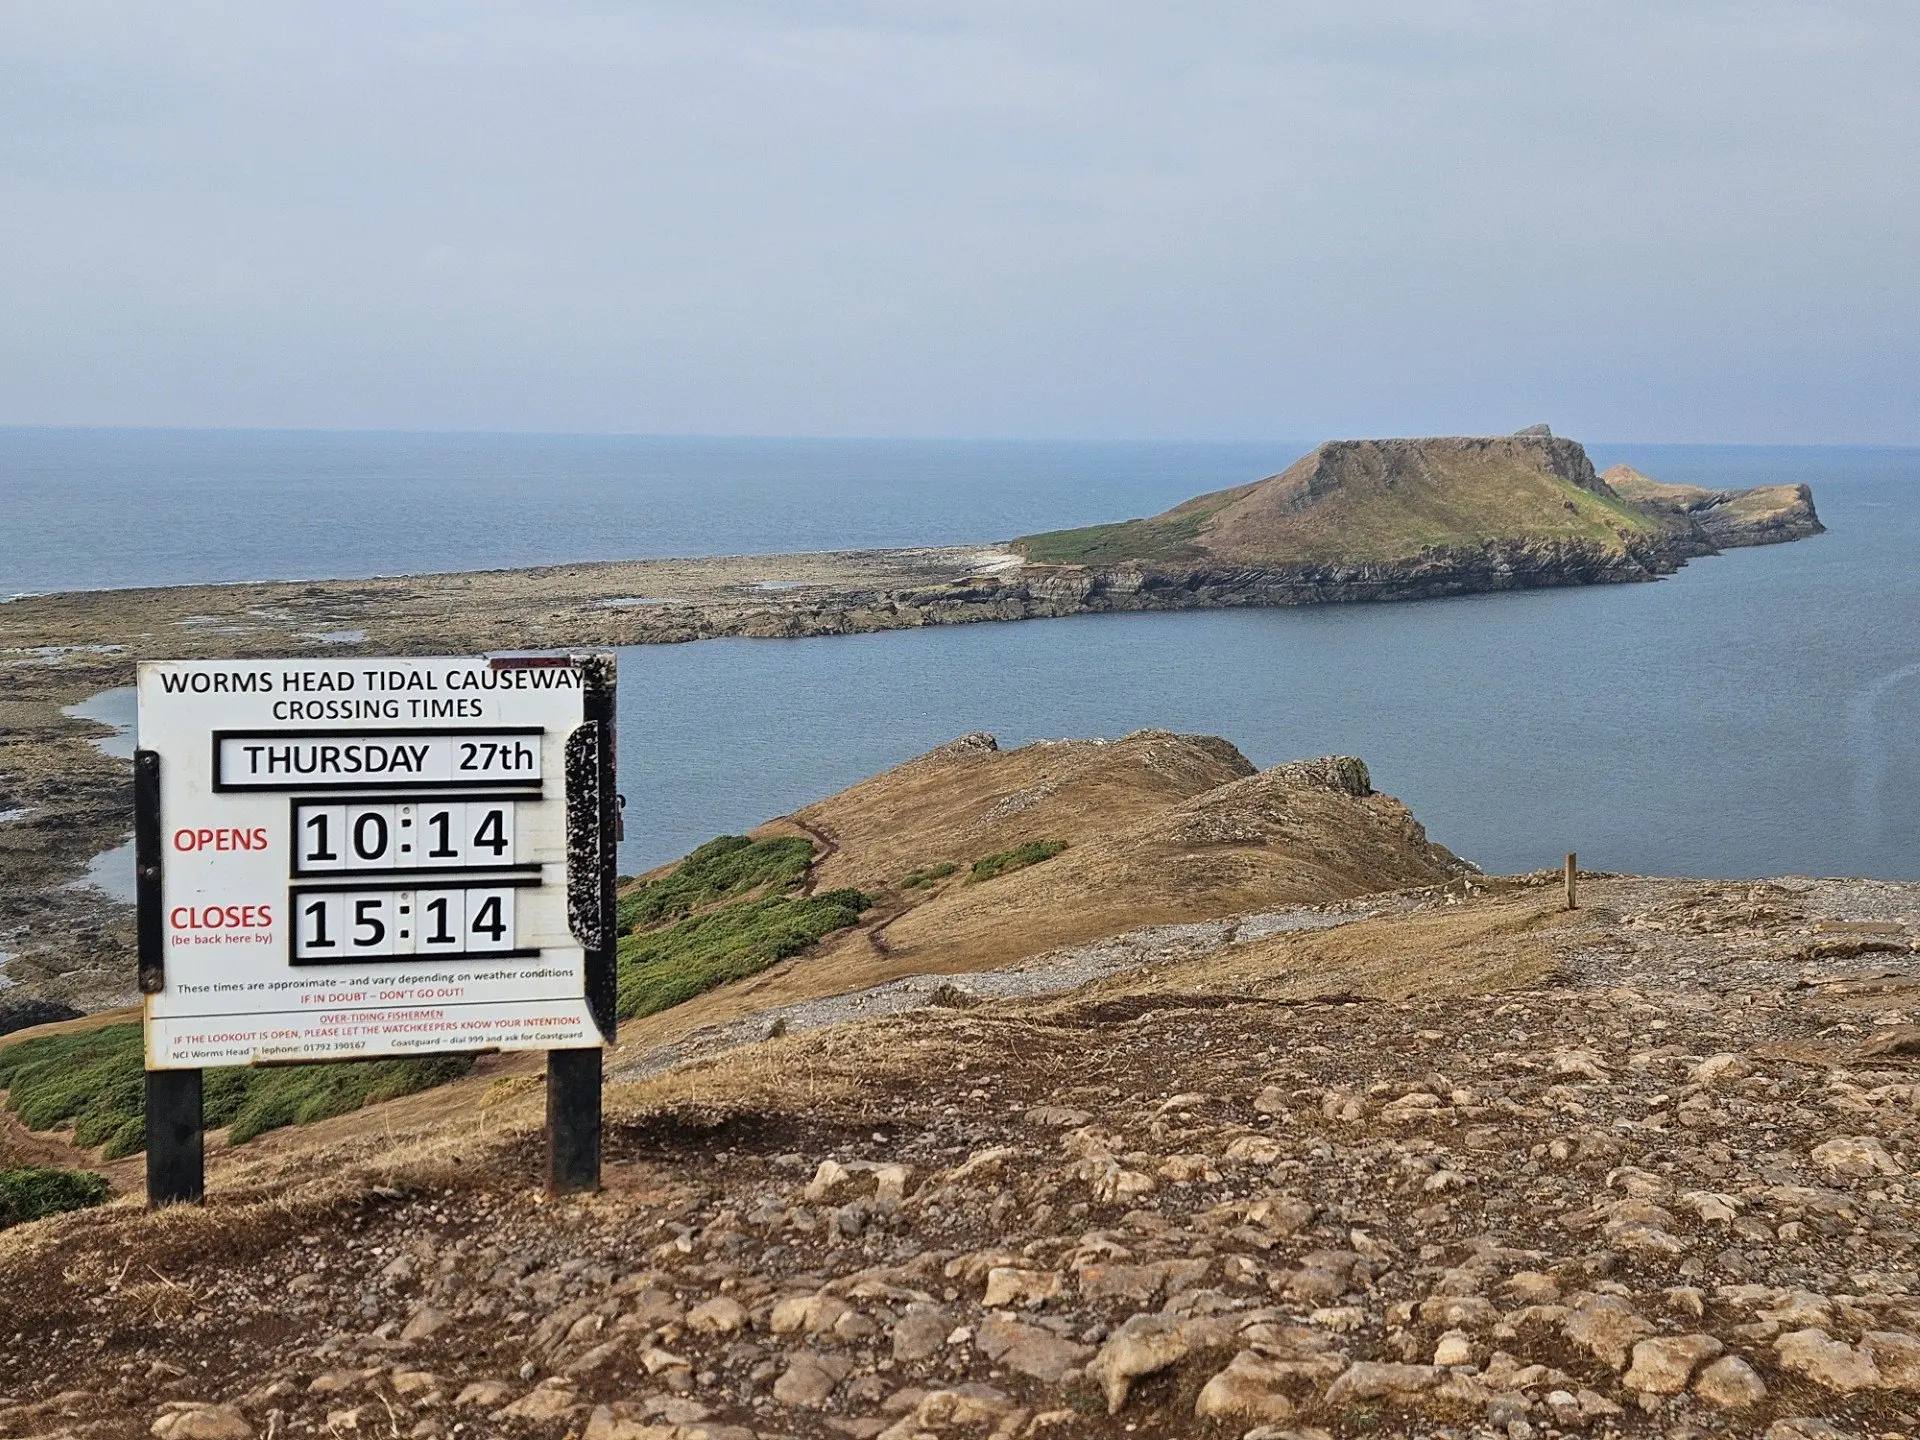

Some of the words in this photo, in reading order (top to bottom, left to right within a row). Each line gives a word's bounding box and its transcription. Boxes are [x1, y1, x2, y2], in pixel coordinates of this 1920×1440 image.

[161, 672, 273, 693] WORMS
[283, 672, 354, 692] HEAD
[363, 671, 438, 691] TIDAL
[446, 670, 583, 690] CAUSEWAY
[273, 700, 399, 720] CROSSING
[407, 698, 483, 718] TIMES
[244, 745, 430, 774] THURSDAY
[460, 742, 534, 770] 27th
[174, 828, 268, 851] OPENS
[306, 810, 508, 861] 10:14
[170, 905, 272, 929] CLOSES
[305, 896, 506, 948] 15:14
[172, 935, 190, 947] (be
[194, 934, 222, 944] back
[226, 934, 251, 944] here
[256, 932, 272, 944] by)
[177, 984, 210, 993] These
[214, 982, 244, 992] times
[248, 982, 264, 990] are
[268, 978, 336, 990] approximate
[349, 976, 369, 986] and
[372, 976, 396, 986] vary
[398, 973, 454, 984] depending
[458, 974, 470, 982] on
[473, 970, 517, 980] weather
[520, 968, 574, 979] conditions
[300, 996, 310, 1004] IF
[314, 994, 325, 1003] IN
[328, 992, 367, 1002] DOUBT
[418, 989, 434, 998] GO
[436, 988, 464, 998] OUT!
[320, 1012, 385, 1024] OVER-TIDING
[388, 1010, 444, 1020] FISHERMEN
[174, 1036, 183, 1044] IF
[186, 1035, 204, 1044] THE
[208, 1032, 257, 1042] LOOKOUT
[260, 1032, 269, 1040] IS
[270, 1030, 301, 1040] OPEN,
[304, 1028, 340, 1038] PLEASE
[342, 1027, 359, 1036] LET
[362, 1026, 380, 1034] THE
[382, 1022, 458, 1034] WATCHKEEPERS
[460, 1020, 492, 1030] KNOW
[494, 1018, 521, 1028] YOUR
[523, 1016, 581, 1026] INTENTIONS
[391, 1038, 440, 1048] Coastguard
[450, 1035, 466, 1044] dial
[468, 1035, 484, 1044] 999
[486, 1034, 502, 1042] and
[504, 1034, 518, 1042] ask
[521, 1032, 533, 1041] for
[535, 1031, 583, 1041] Coastguard
[172, 1051, 188, 1059] NCI
[191, 1050, 224, 1058] Worms
[226, 1048, 250, 1056] Head
[252, 1045, 302, 1054] Tlephone:
[304, 1043, 331, 1052] 01792
[334, 1041, 366, 1050] 390167
